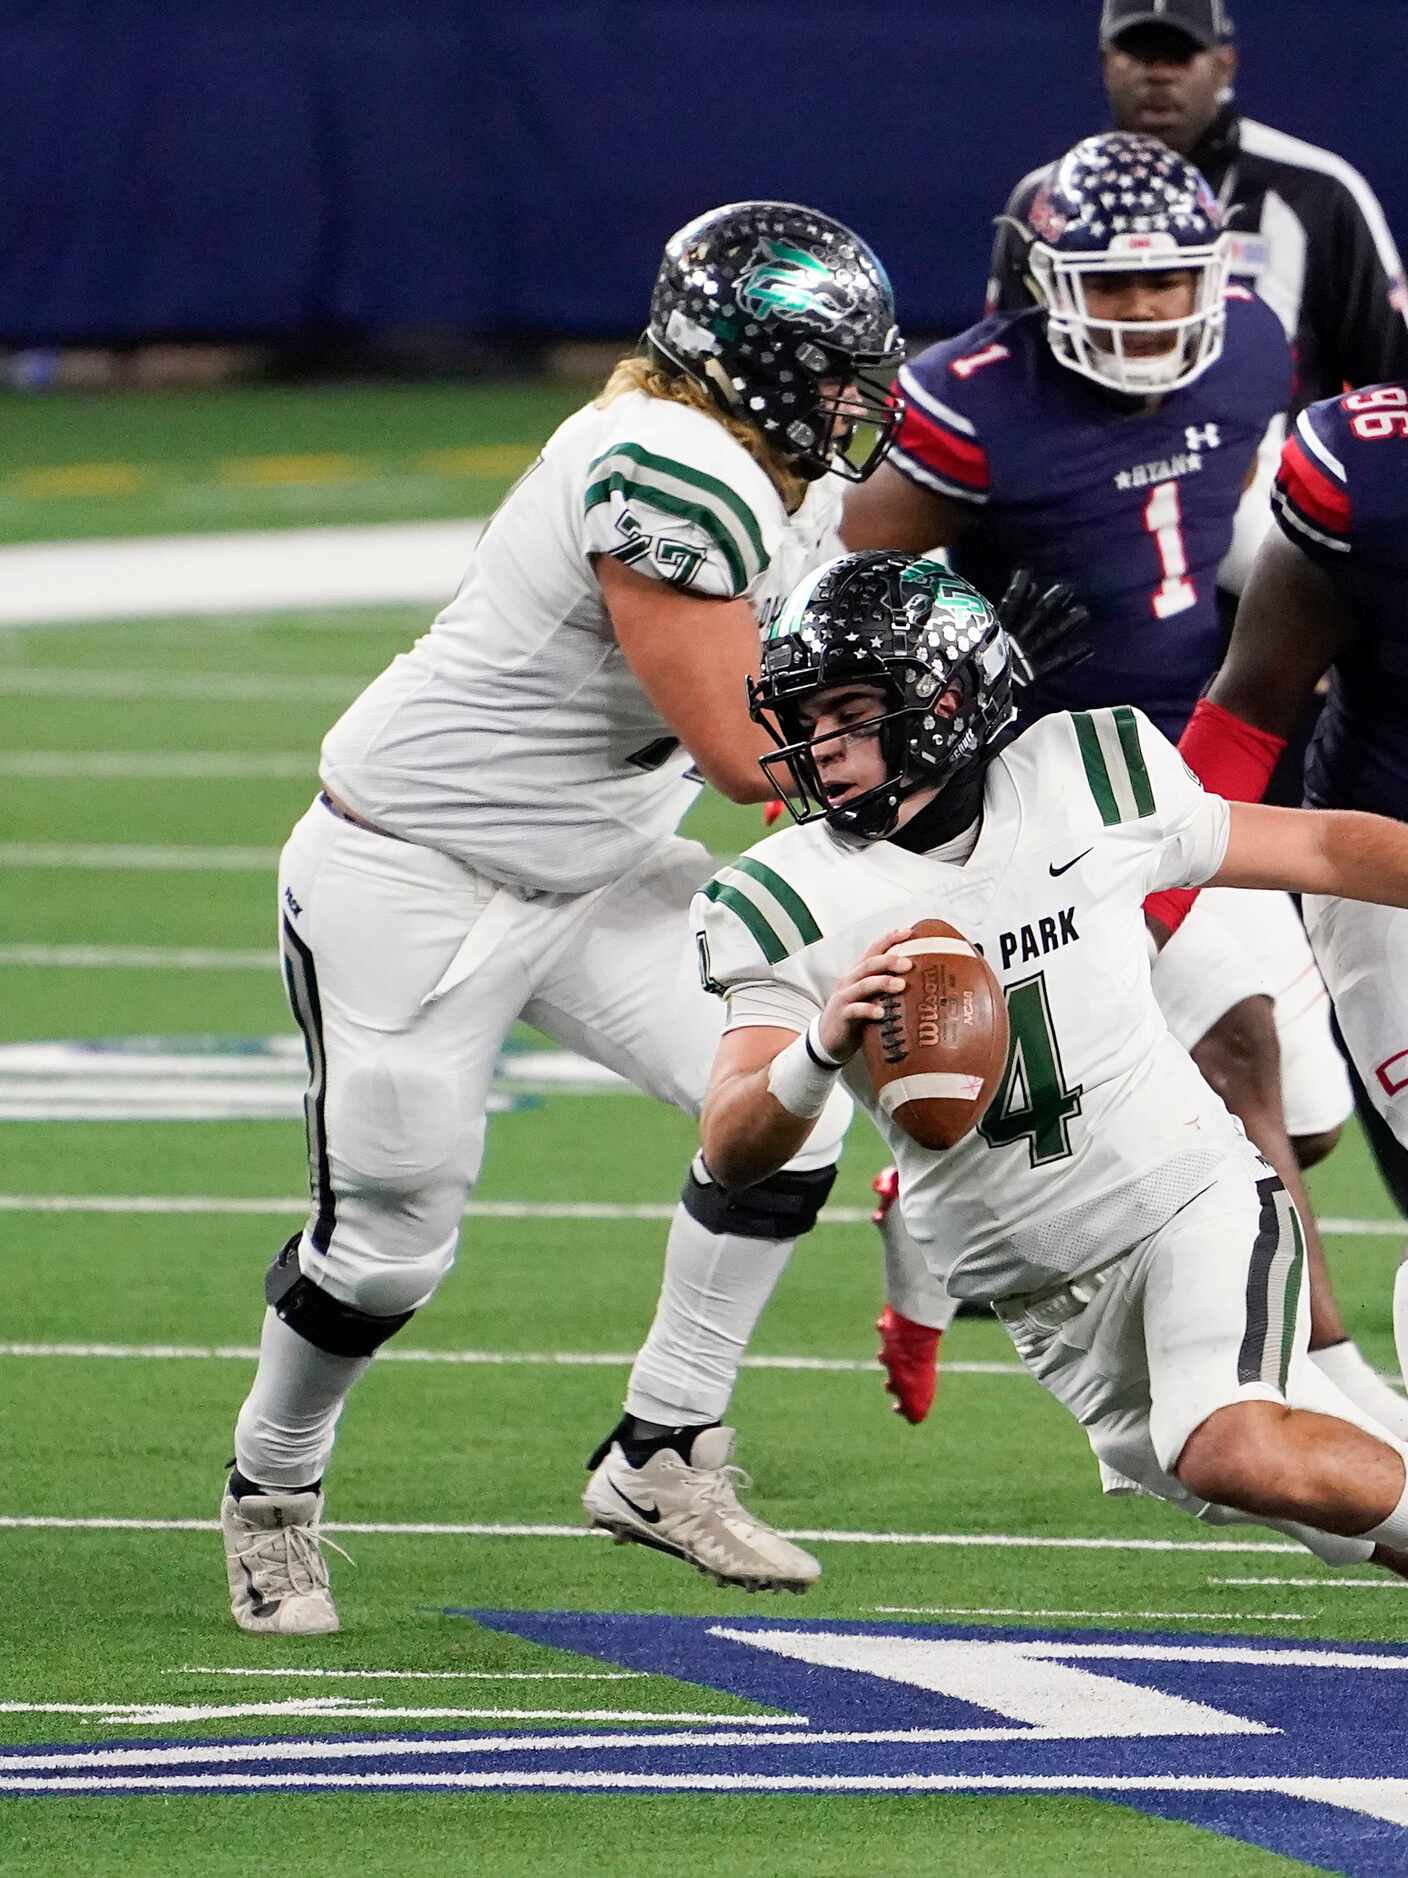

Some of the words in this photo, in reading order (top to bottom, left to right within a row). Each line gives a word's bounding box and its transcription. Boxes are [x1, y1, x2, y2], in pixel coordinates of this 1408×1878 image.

[947, 342, 1009, 380] 1
[1144, 479, 1198, 620] 1
[999, 905, 1081, 971] PARK
[917, 963, 940, 1048] Wilson
[977, 969, 1083, 1169] 4
